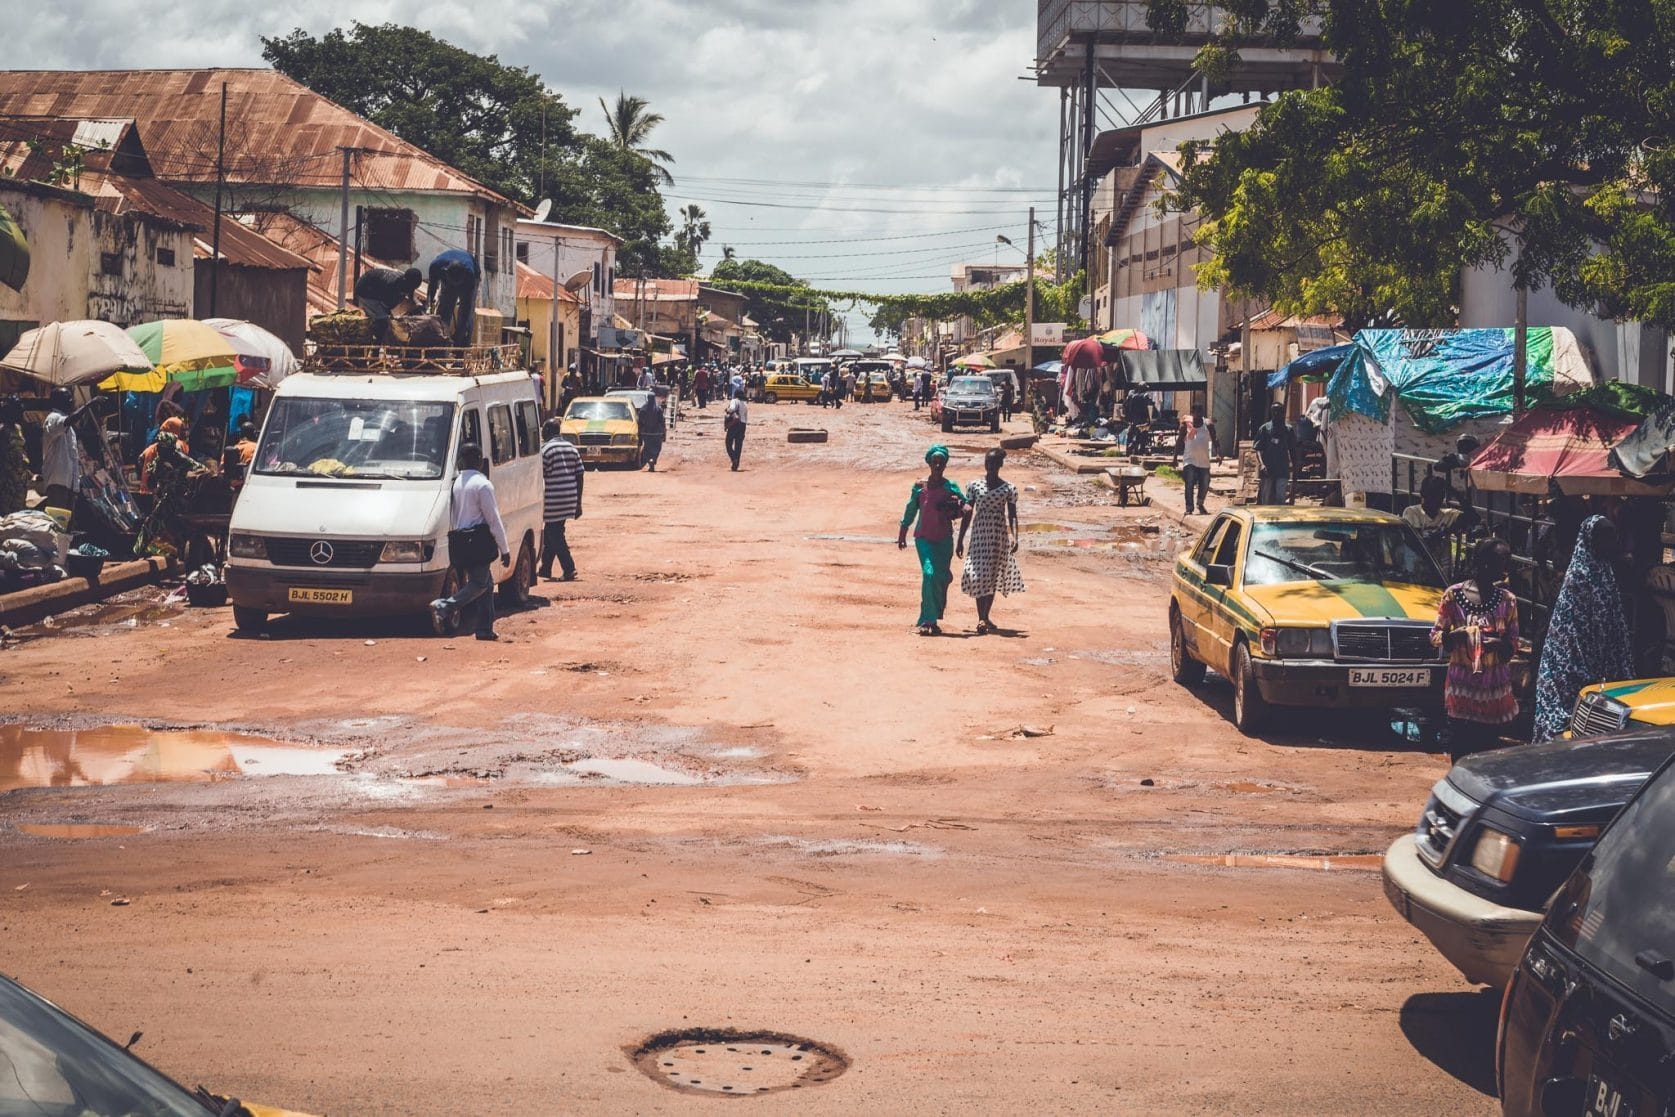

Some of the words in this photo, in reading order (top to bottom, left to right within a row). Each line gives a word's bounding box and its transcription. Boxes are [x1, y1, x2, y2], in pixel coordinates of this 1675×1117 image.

[292, 590, 309, 600] BJL
[312, 591, 339, 601] 5502
[340, 592, 348, 602] H
[1353, 672, 1377, 683] BJL
[1381, 672, 1414, 684] 5024
[1416, 672, 1425, 683] F
